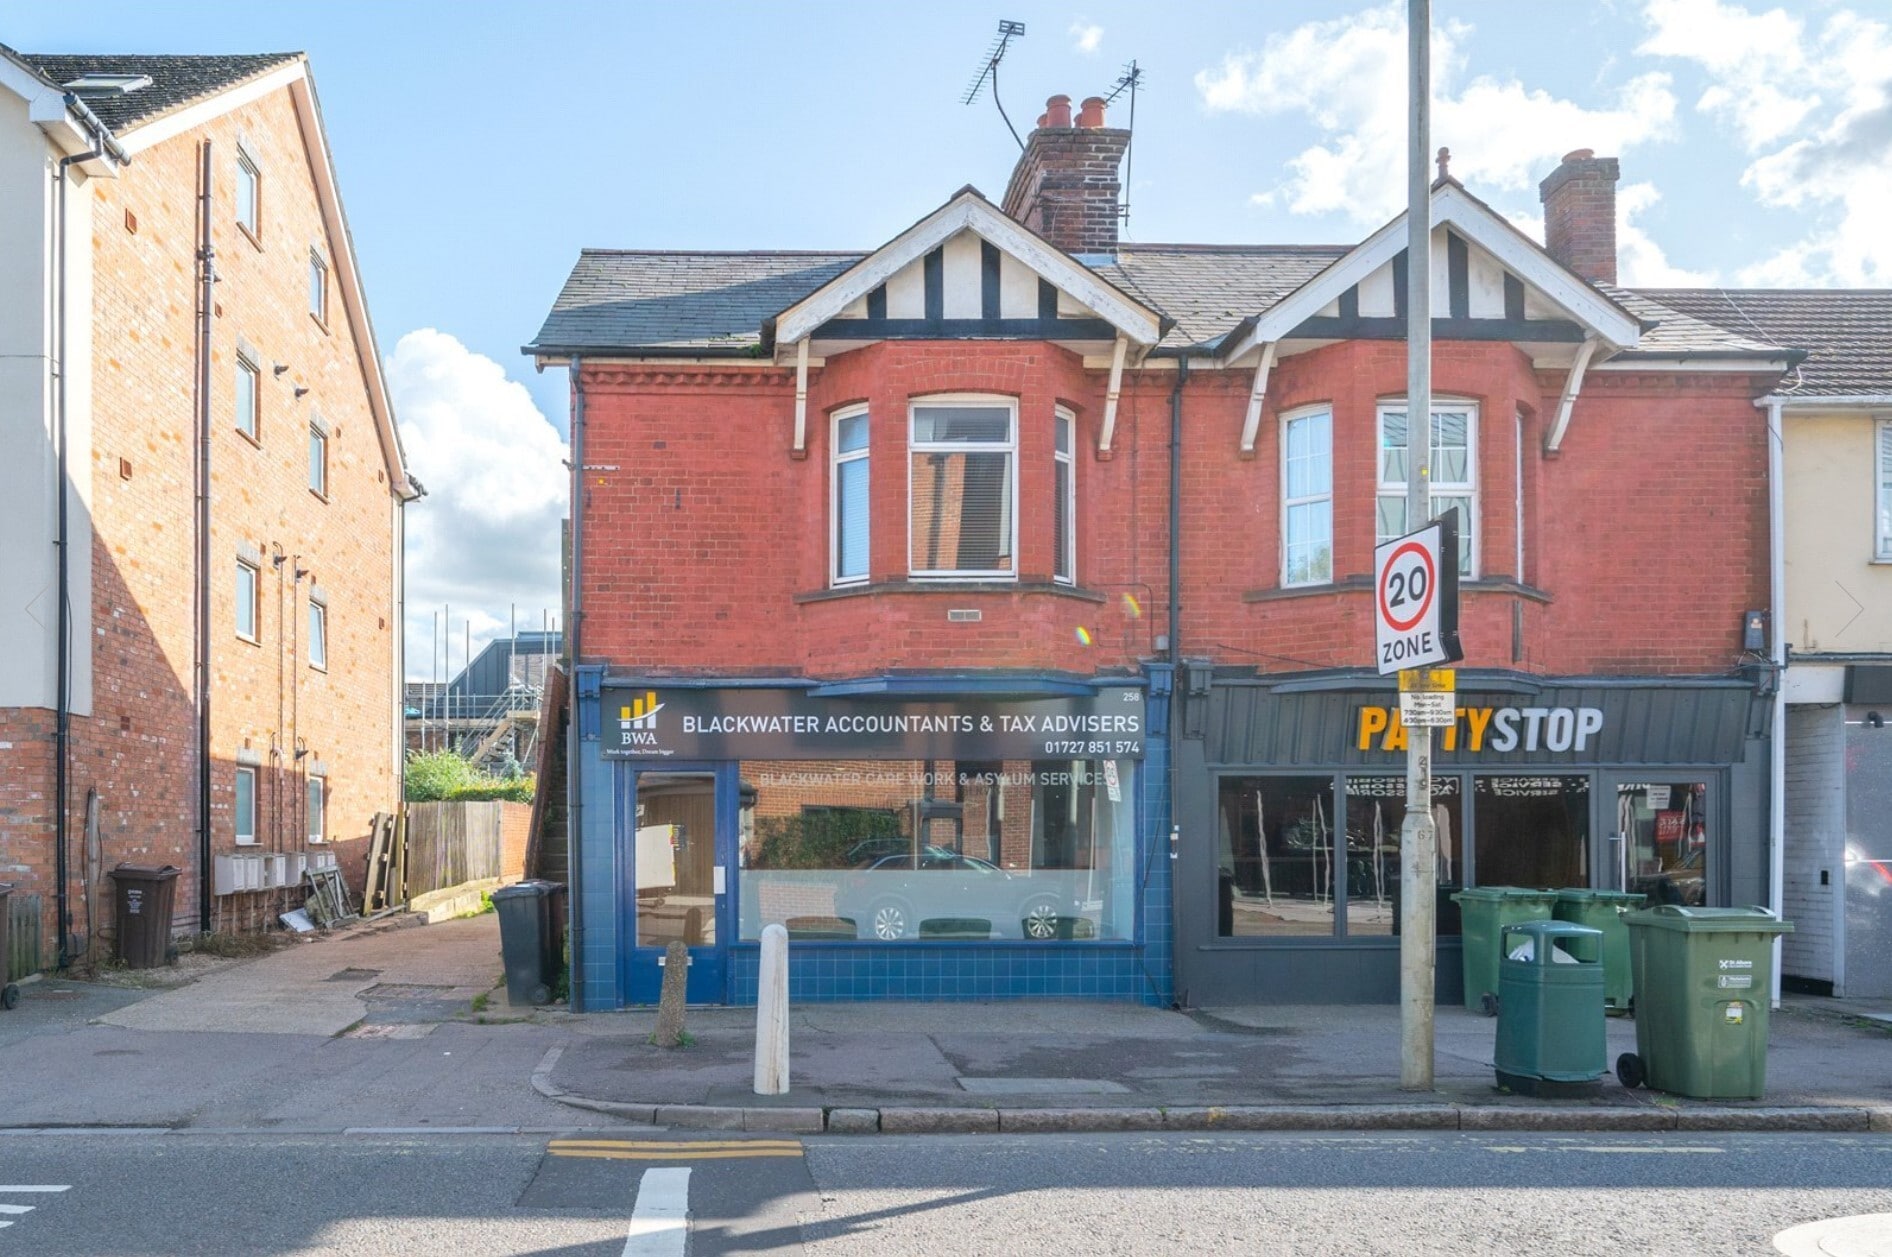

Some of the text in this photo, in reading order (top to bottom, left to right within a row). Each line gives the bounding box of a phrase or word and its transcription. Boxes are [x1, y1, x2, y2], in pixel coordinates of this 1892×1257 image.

[1389, 565, 1427, 609] 20
[1382, 631, 1433, 665] ZONE
[1123, 692, 1139, 702] 258
[683, 715, 1140, 734] BLACKWATER ACCOUNTANTS & TAX ADVISERS
[621, 732, 658, 745] BWA
[1045, 741, 1140, 754] 01727 851 574
[760, 773, 861, 786] BLACKWATER
[865, 773, 905, 786] CARE
[909, 773, 956, 786] WORK
[959, 773, 971, 785] &
[975, 772, 1036, 786] ASYLUM
